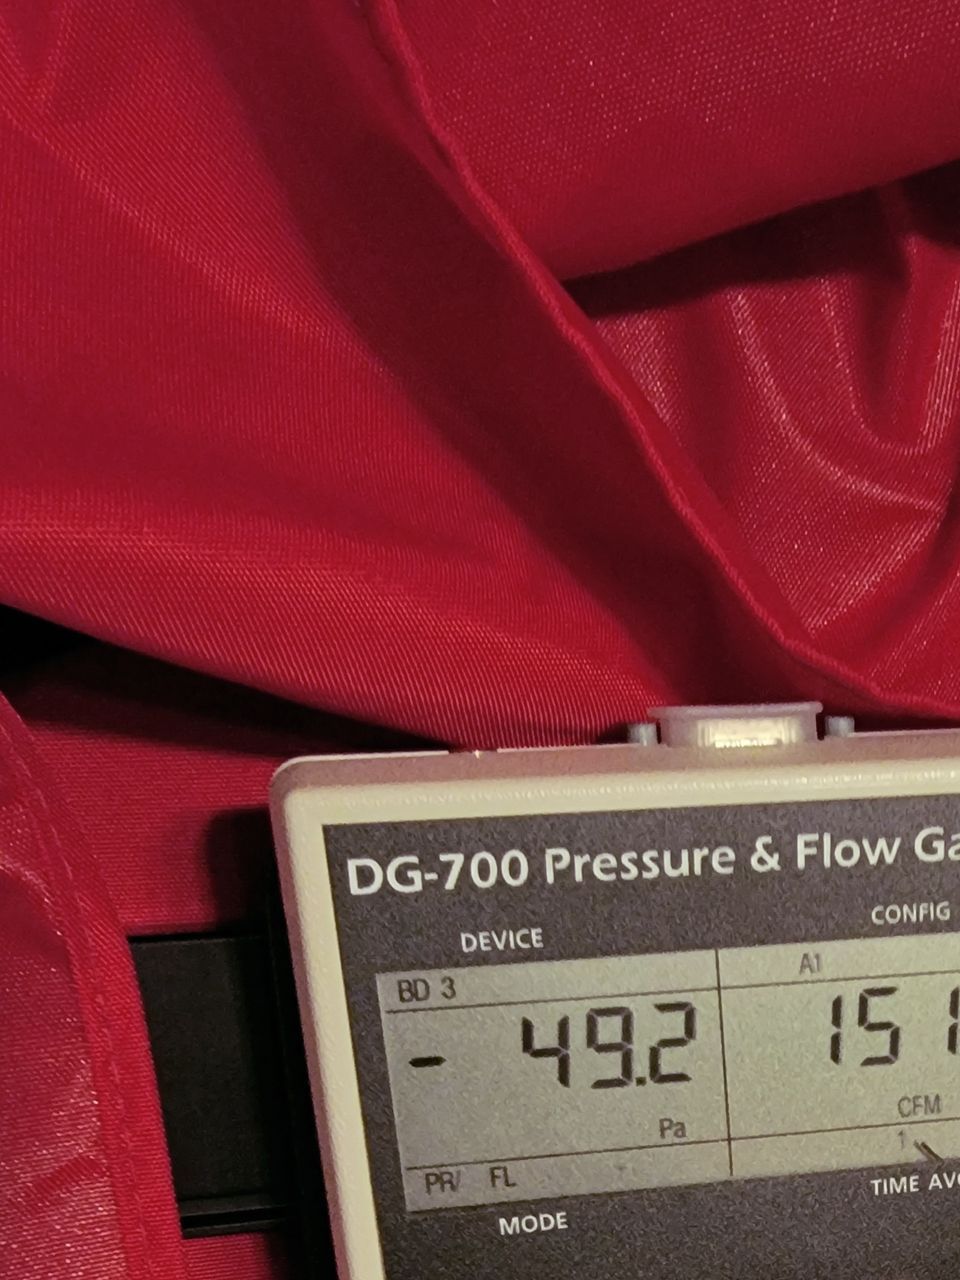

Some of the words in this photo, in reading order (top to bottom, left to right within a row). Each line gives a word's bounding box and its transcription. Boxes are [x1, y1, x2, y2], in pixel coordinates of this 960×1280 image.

[347, 848, 529, 896] DG-700
[545, 843, 736, 884] Pressure
[750, 836, 781, 873] &
[796, 832, 899, 869] Flow
[871, 901, 951, 925] CONFIG
[461, 928, 544, 952] DEVICE
[799, 952, 822, 975] A1
[397, 978, 430, 1003] BD
[440, 977, 457, 1000] 3
[522, 1001, 697, 1088] 49.2
[898, 1094, 942, 1119] CFM
[659, 1118, 687, 1139] Pa
[490, 1166, 516, 1189] FL
[871, 1176, 919, 1196] TIME
[500, 1212, 568, 1236] MODE
